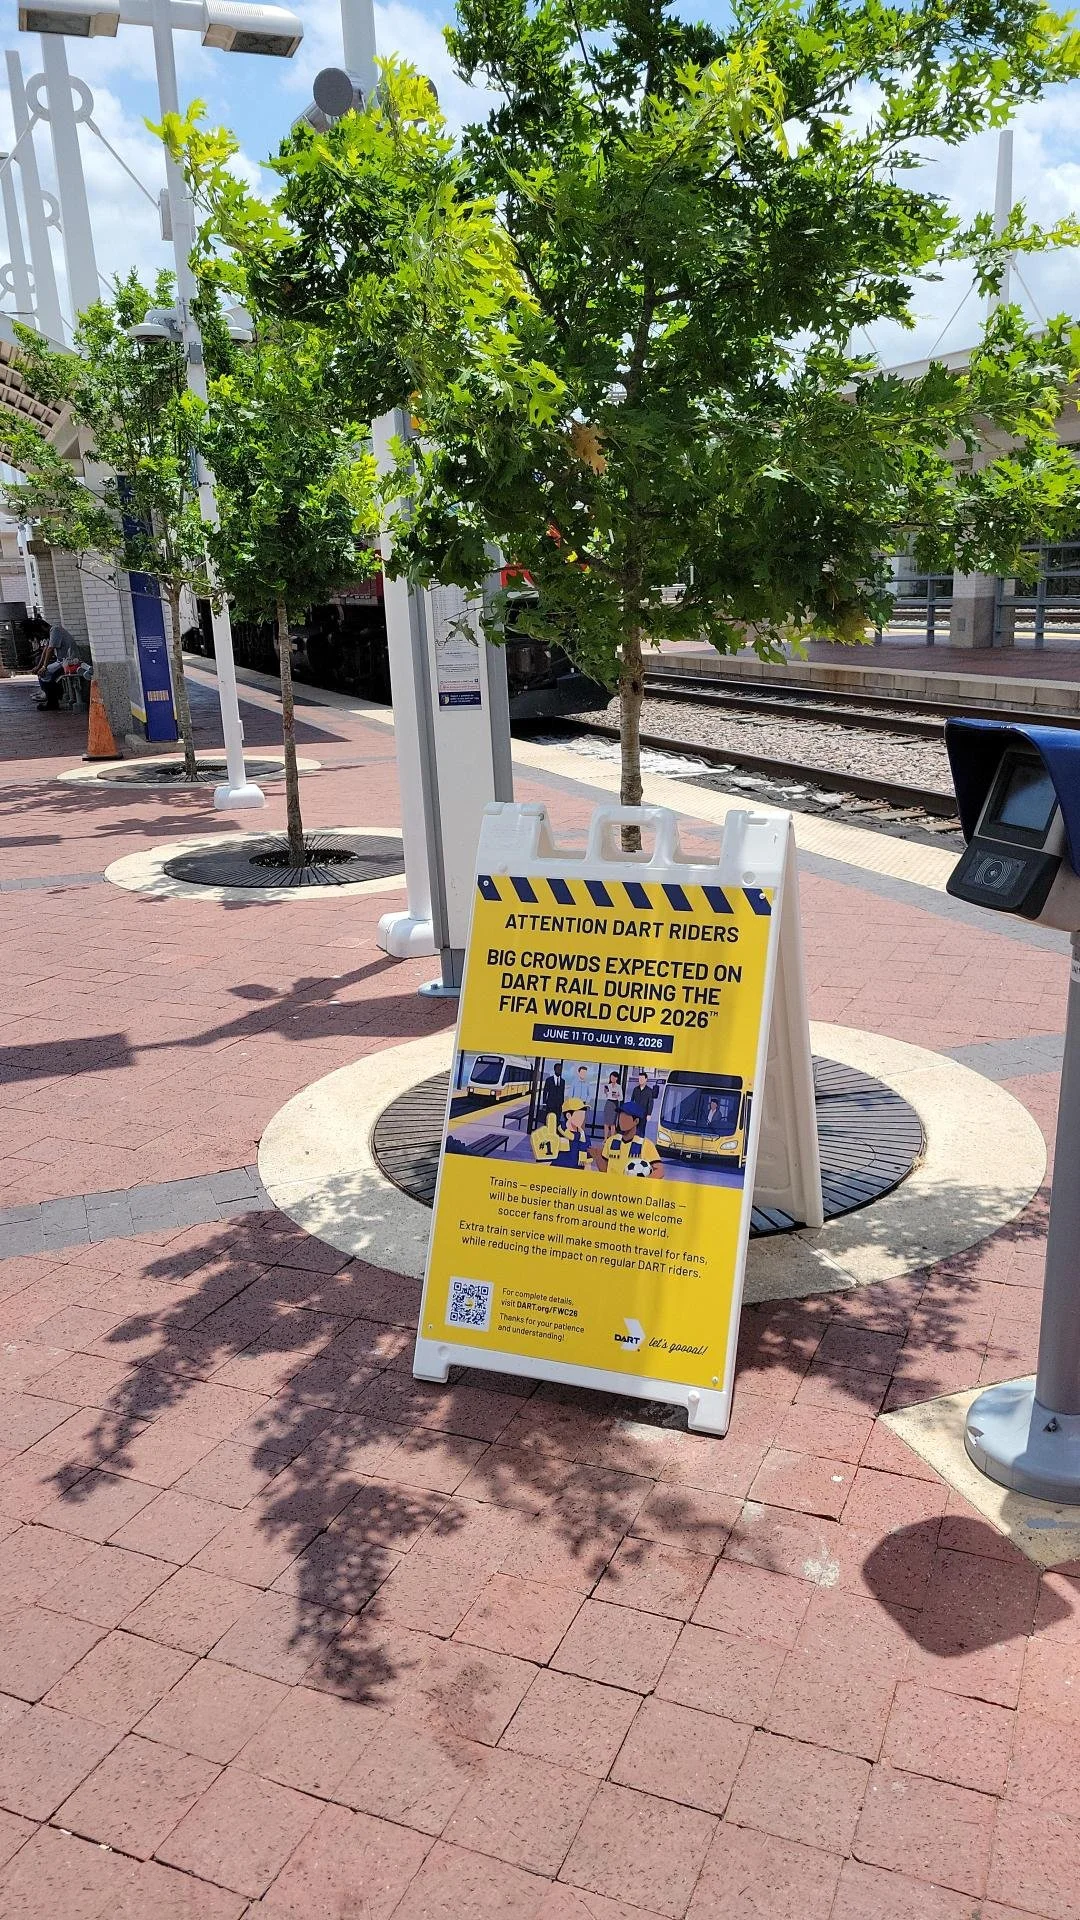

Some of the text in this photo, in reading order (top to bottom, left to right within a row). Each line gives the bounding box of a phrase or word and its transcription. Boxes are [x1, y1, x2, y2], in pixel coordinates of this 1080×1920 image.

[504, 913, 740, 943] ATTENTION DART RIDERS
[487, 948, 743, 984] BIG CROWDS EXPECTED ON
[501, 972, 722, 1006] DART RAIL DURING THE
[499, 994, 538, 1015] FIFA
[544, 998, 612, 1021] WORLD
[616, 1004, 656, 1024] CUP
[543, 1028, 663, 1049] JUNE 11 TO JULY 19, 2026
[539, 1140, 553, 1156] #1
[489, 1176, 518, 1189] Trains
[529, 1183, 578, 1199] especially
[579, 1187, 589, 1198] in
[591, 1189, 643, 1205] downtown
[645, 1196, 676, 1210] Dallas
[489, 1191, 683, 1225] will be busier than usual as we welcome
[497, 1207, 669, 1239] soccer fans from around the world.
[459, 1219, 708, 1265] Extra train service will make smooth travel for fans,
[461, 1235, 701, 1279] while reducing the impact on regular DART riders.
[501, 1299, 578, 1318] visit DART.org/FWC26
[502, 1287, 515, 1296] For
[514, 1291, 548, 1302] complete
[497, 1324, 565, 1343] and understanding!
[499, 1312, 585, 1334] Thanks for your patience
[614, 1333, 641, 1345] DART
